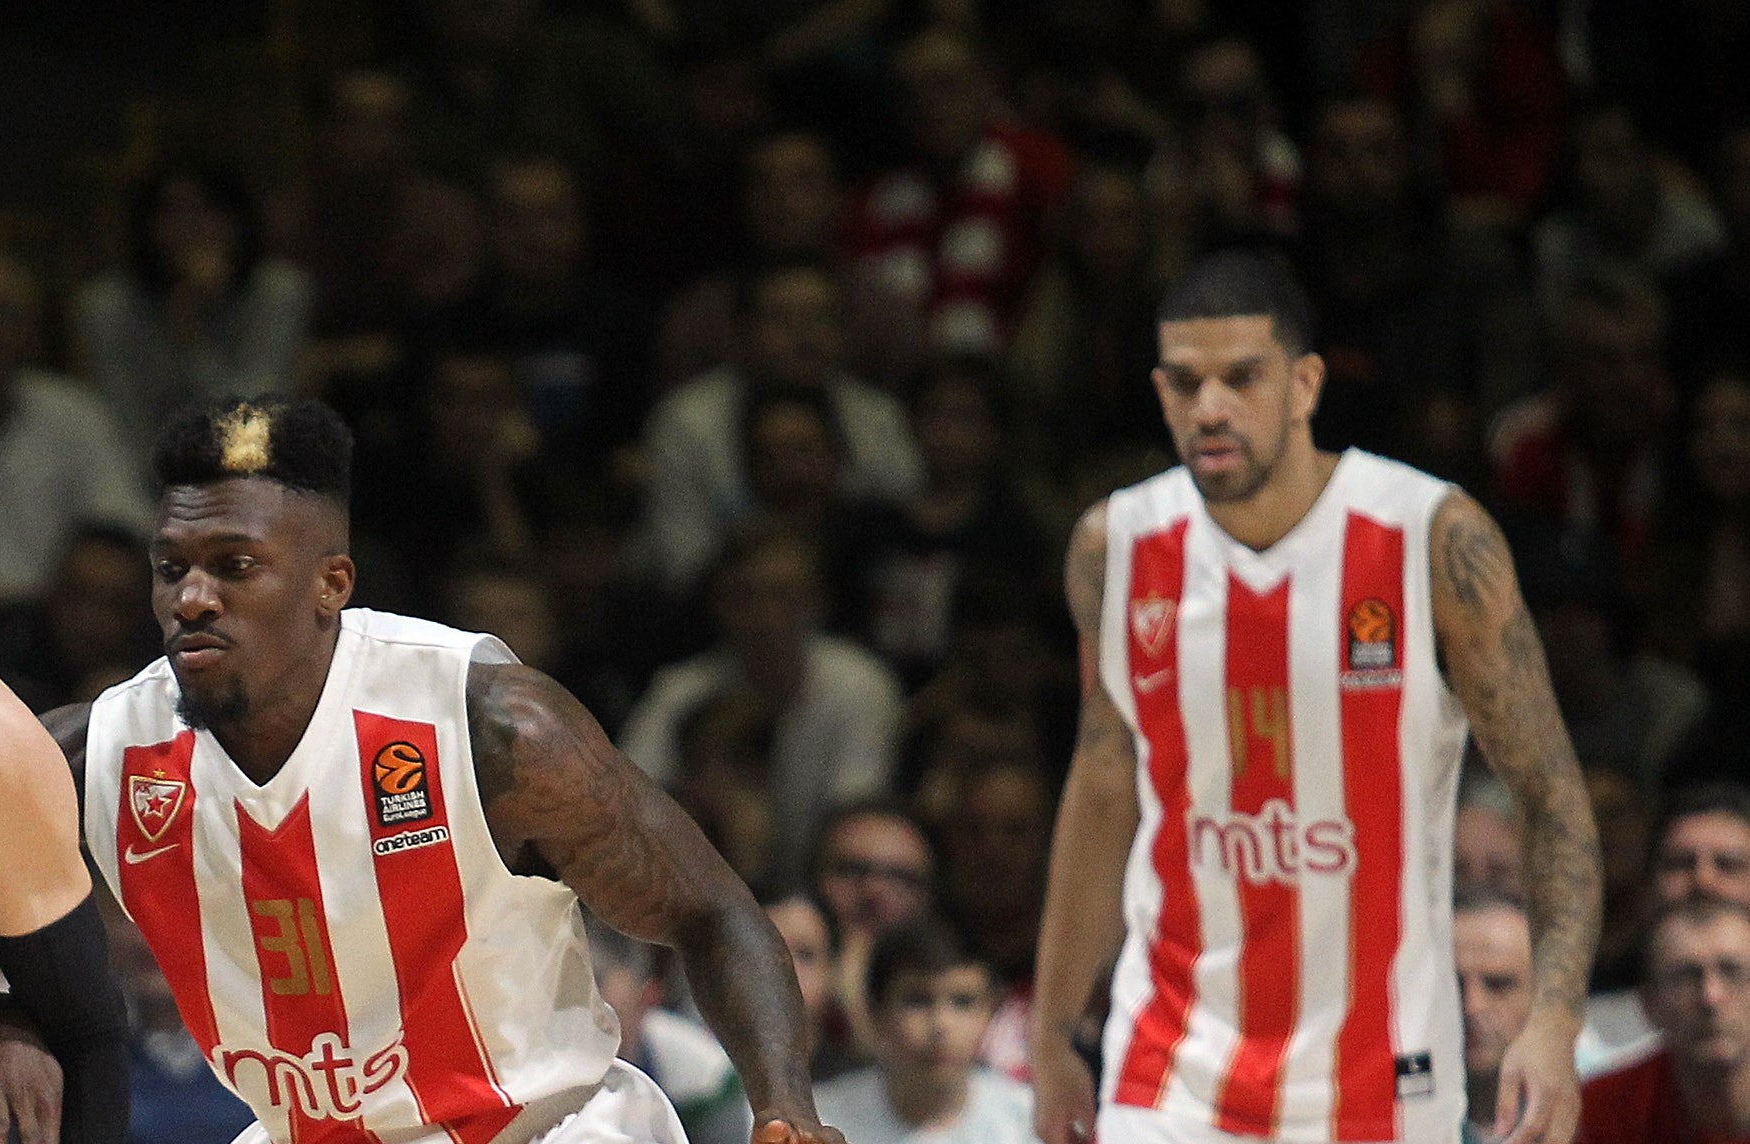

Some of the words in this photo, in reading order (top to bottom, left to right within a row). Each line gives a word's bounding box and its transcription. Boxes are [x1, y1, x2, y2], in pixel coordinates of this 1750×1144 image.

[1228, 686, 1292, 780] 14
[380, 790, 425, 806] TURKISH
[382, 798, 427, 815] AIRLINES
[375, 828, 447, 853] oneteam
[1191, 807, 1349, 876] mts
[252, 896, 332, 996] 31
[220, 1038, 402, 1114] mts
